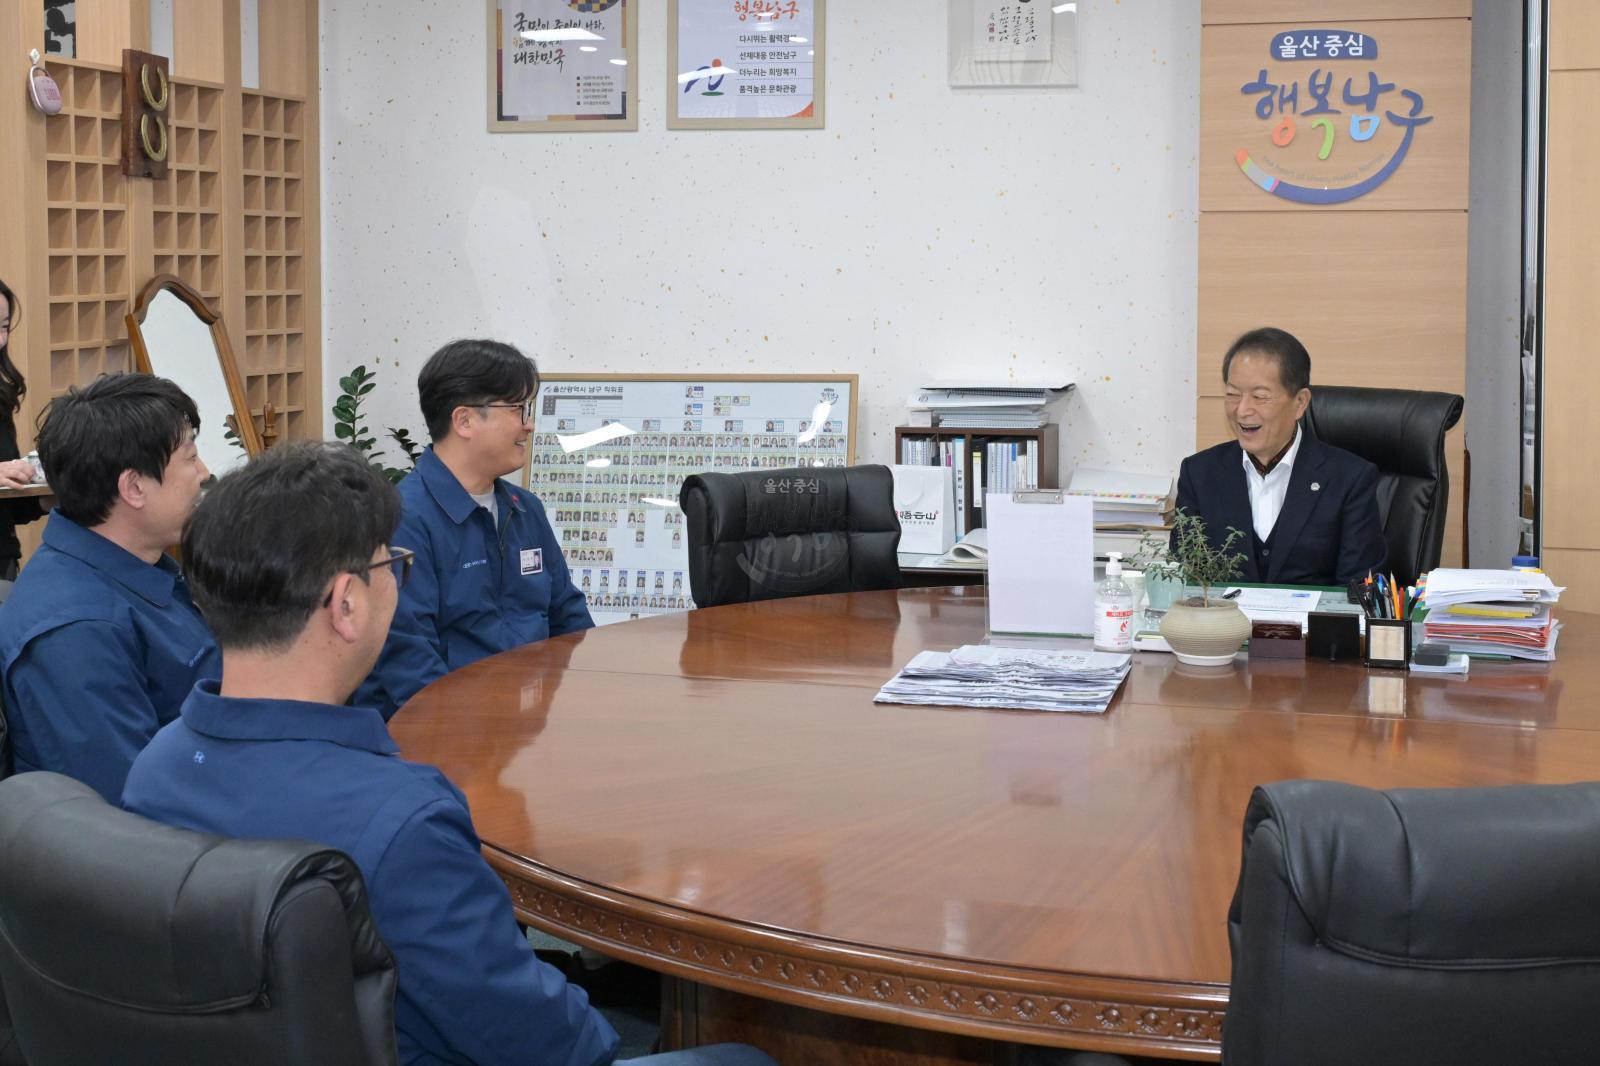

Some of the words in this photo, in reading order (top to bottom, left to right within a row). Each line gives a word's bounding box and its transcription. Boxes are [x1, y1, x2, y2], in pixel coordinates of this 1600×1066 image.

[513, 12, 549, 32] 국민이
[739, 34, 767, 43] 다시뛰는
[769, 34, 797, 44] 활력경
[513, 48, 566, 73] 대한민국
[769, 51, 797, 60] 안전남구
[739, 68, 767, 77] 더누리는
[769, 68, 797, 77] 희망복지
[739, 84, 767, 94] 품격높은
[769, 84, 797, 94] 문화관광
[1240, 68, 1434, 160] 행복남구
